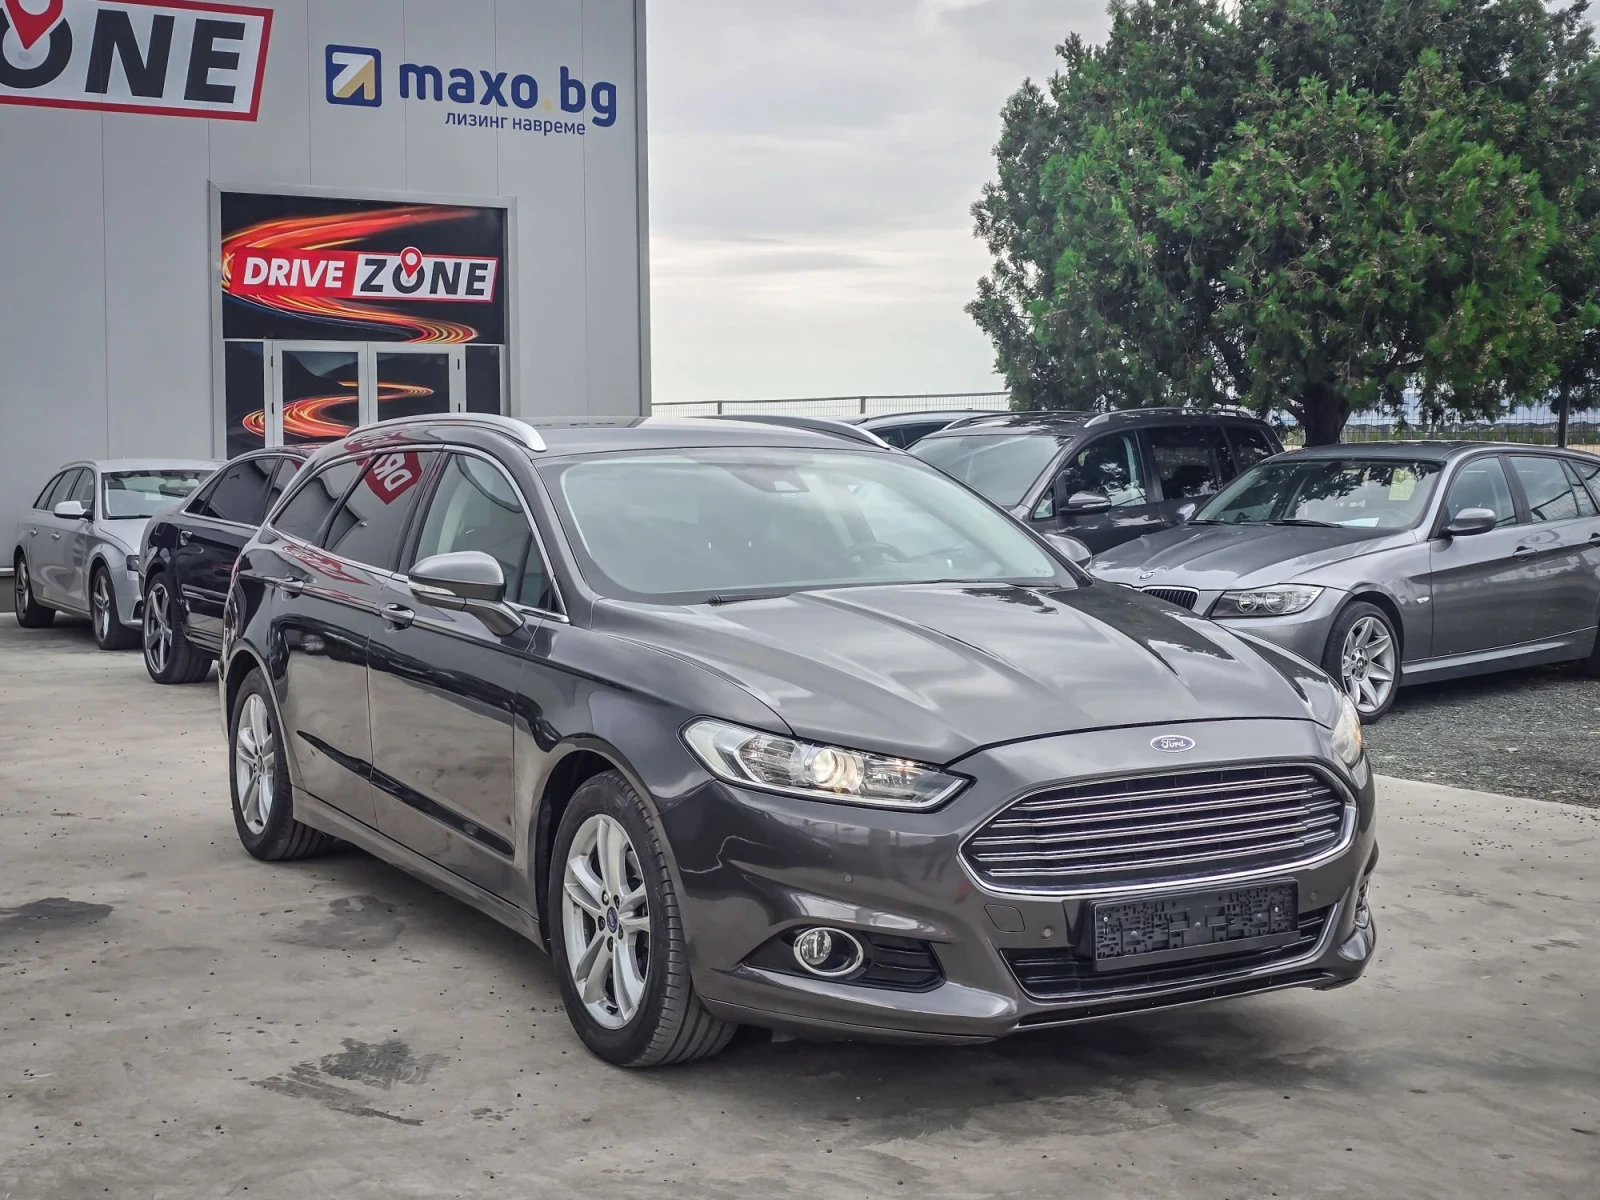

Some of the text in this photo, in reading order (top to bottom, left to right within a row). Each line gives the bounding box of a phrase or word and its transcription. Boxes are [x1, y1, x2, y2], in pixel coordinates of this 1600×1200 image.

[399, 63, 617, 127] maxo.bg
[445, 112, 586, 136] лизинг навреме
[243, 256, 489, 296] DRIVE ZONE
